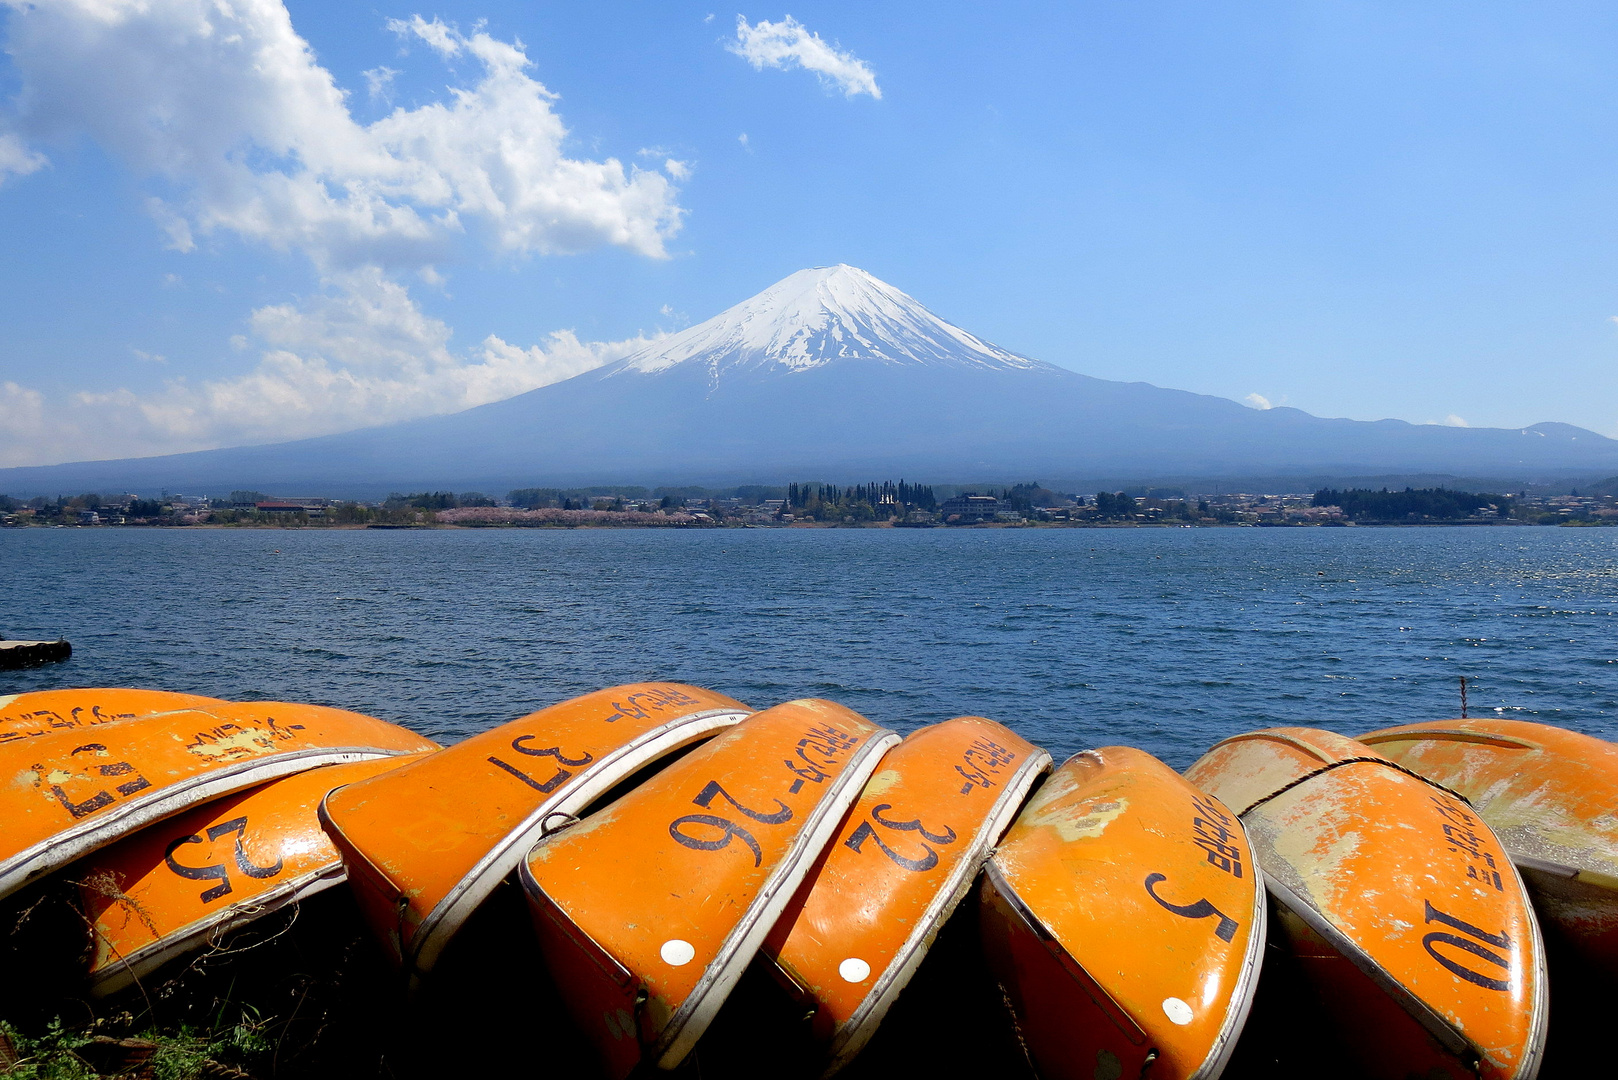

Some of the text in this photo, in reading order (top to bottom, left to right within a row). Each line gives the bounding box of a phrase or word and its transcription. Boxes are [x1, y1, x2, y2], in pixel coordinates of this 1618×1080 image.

[486, 734, 593, 793] 37
[165, 816, 284, 904] 25
[669, 780, 794, 867] 26
[844, 803, 957, 872] 32
[1144, 872, 1240, 944] 5
[1422, 899, 1513, 992] 10
